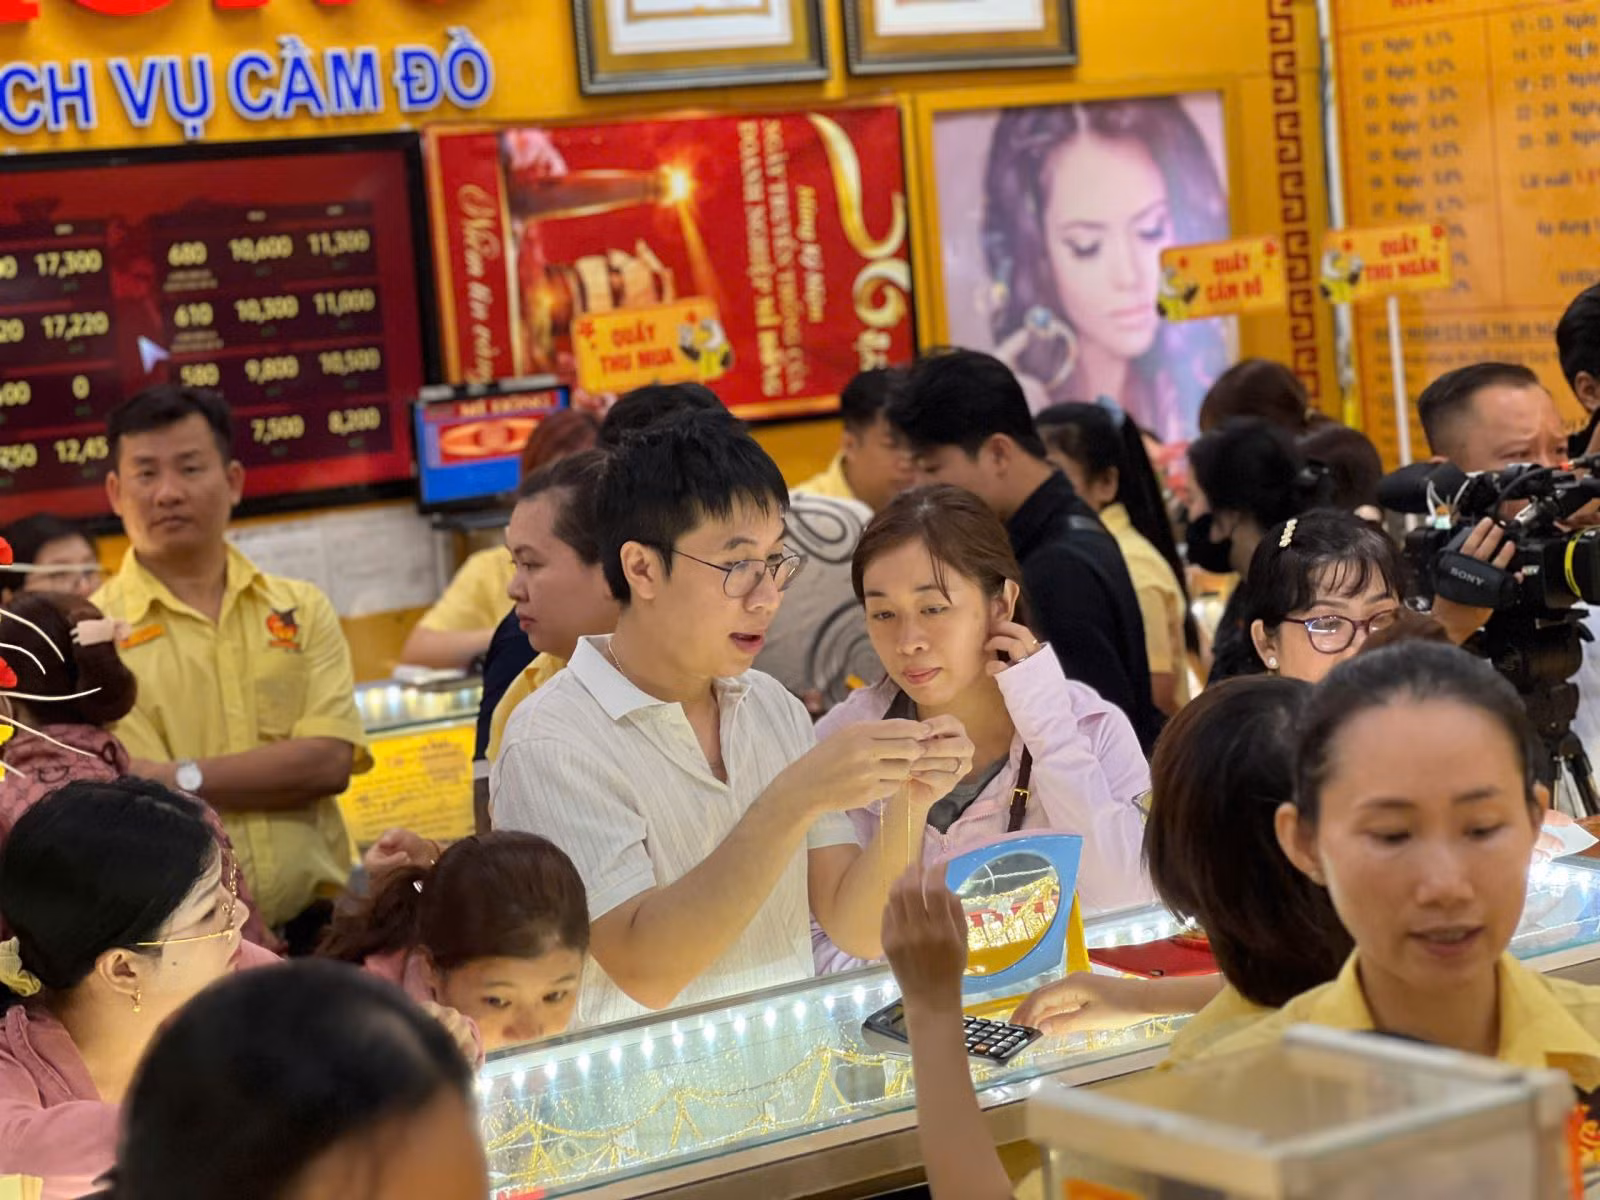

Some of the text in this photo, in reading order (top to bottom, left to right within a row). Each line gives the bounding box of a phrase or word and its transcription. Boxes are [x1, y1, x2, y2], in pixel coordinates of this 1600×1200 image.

[0, 26, 495, 140] CH VỤ CẦM ĐỒ
[35, 249, 103, 277] 17,300
[41, 311, 109, 341] 17,220
[72, 375, 90, 399] 0
[1450, 566, 1486, 587] SONY
